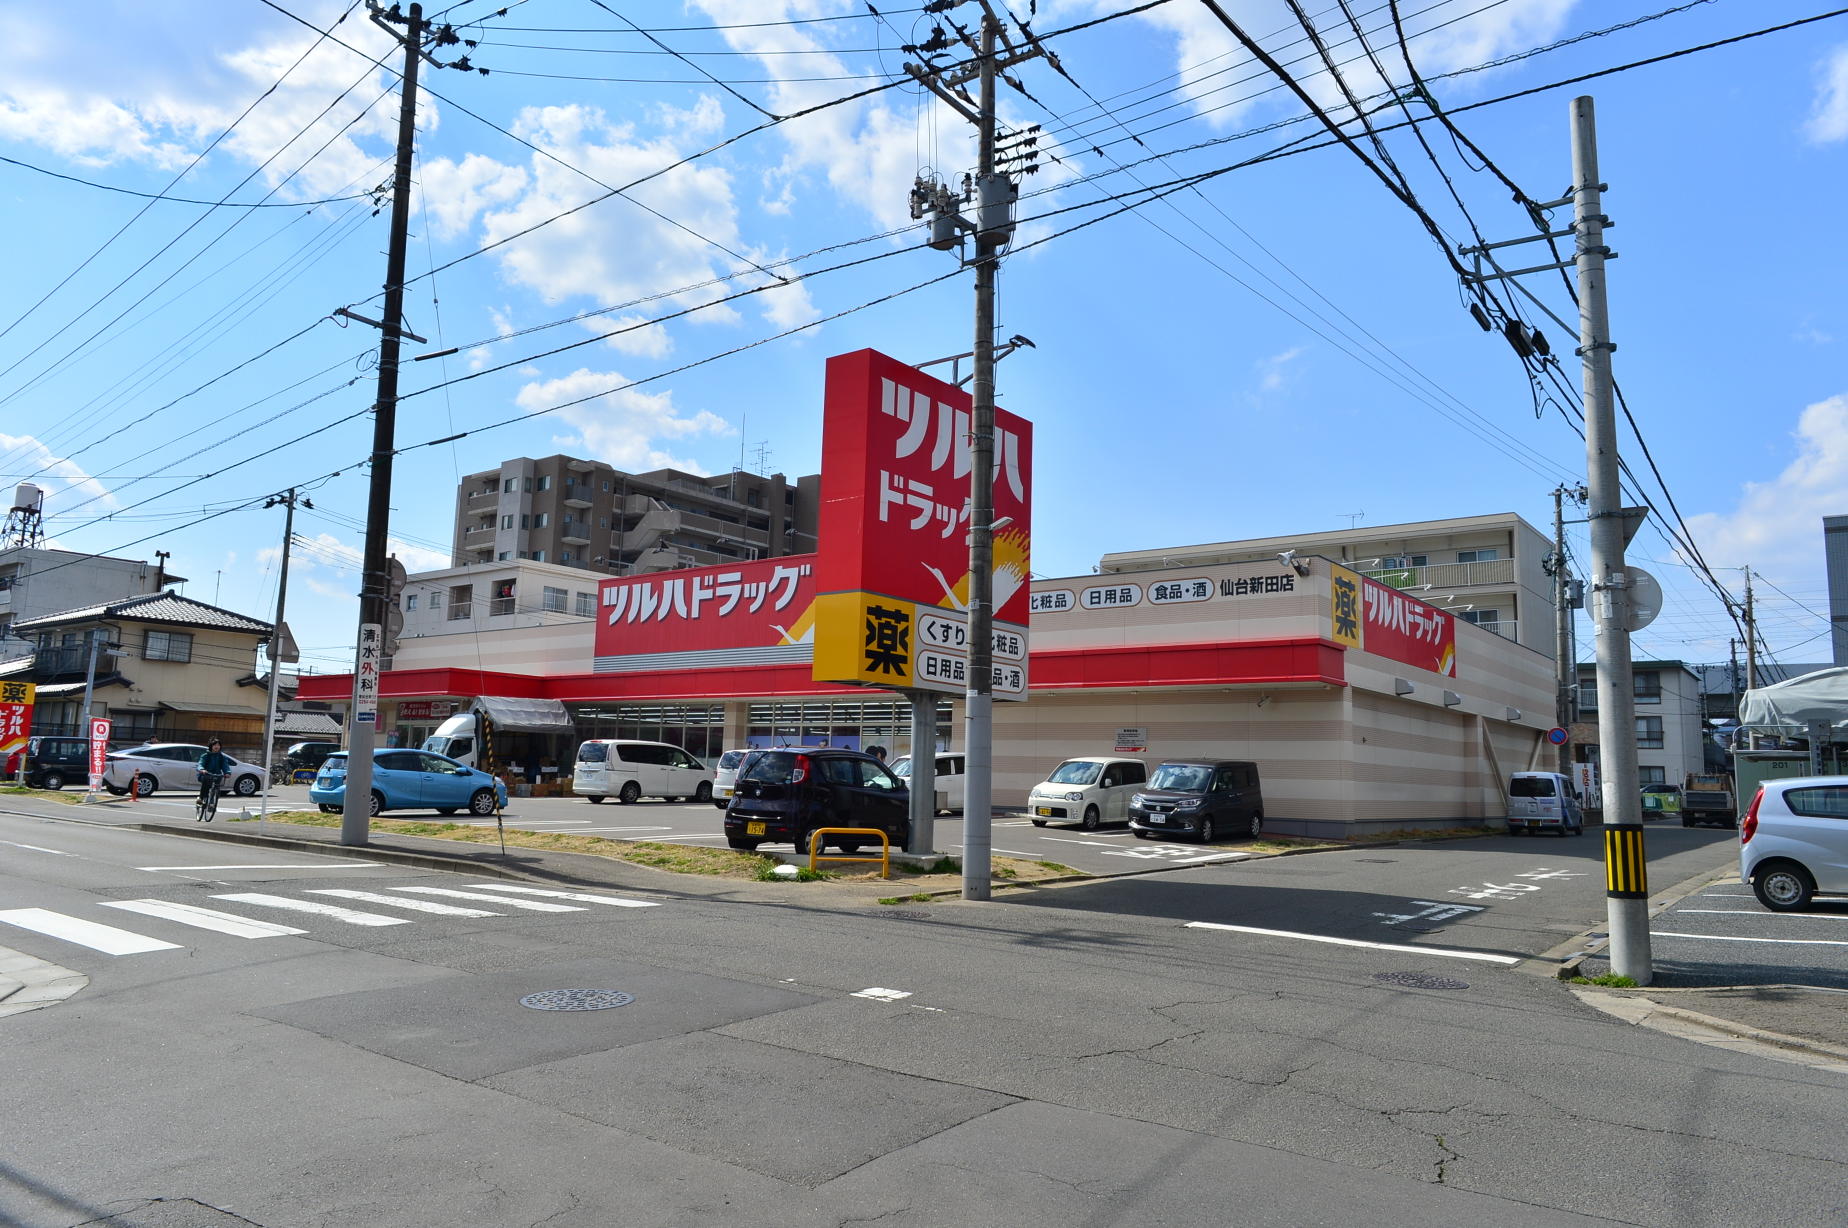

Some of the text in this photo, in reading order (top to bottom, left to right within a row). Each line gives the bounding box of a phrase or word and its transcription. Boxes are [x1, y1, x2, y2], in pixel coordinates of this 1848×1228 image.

[881, 376, 1024, 503] ツルハ
[603, 564, 811, 626] ツルハドラッグ
[1089, 588, 1132, 605] 日用品
[1154, 582, 1207, 600] 食品・酒
[1219, 573, 1294, 597] 仙台新田店
[1335, 576, 1356, 640] 薬
[926, 617, 965, 645] くすり
[1364, 583, 1444, 645] ツルハドラッグ
[361, 629, 376, 691] 清水外科
[865, 605, 909, 677] 薬
[926, 655, 964, 680] 日用品
[2, 683, 27, 703] 薬
[8, 705, 24, 735] ツルハ
[1772, 761, 1788, 769] 201
